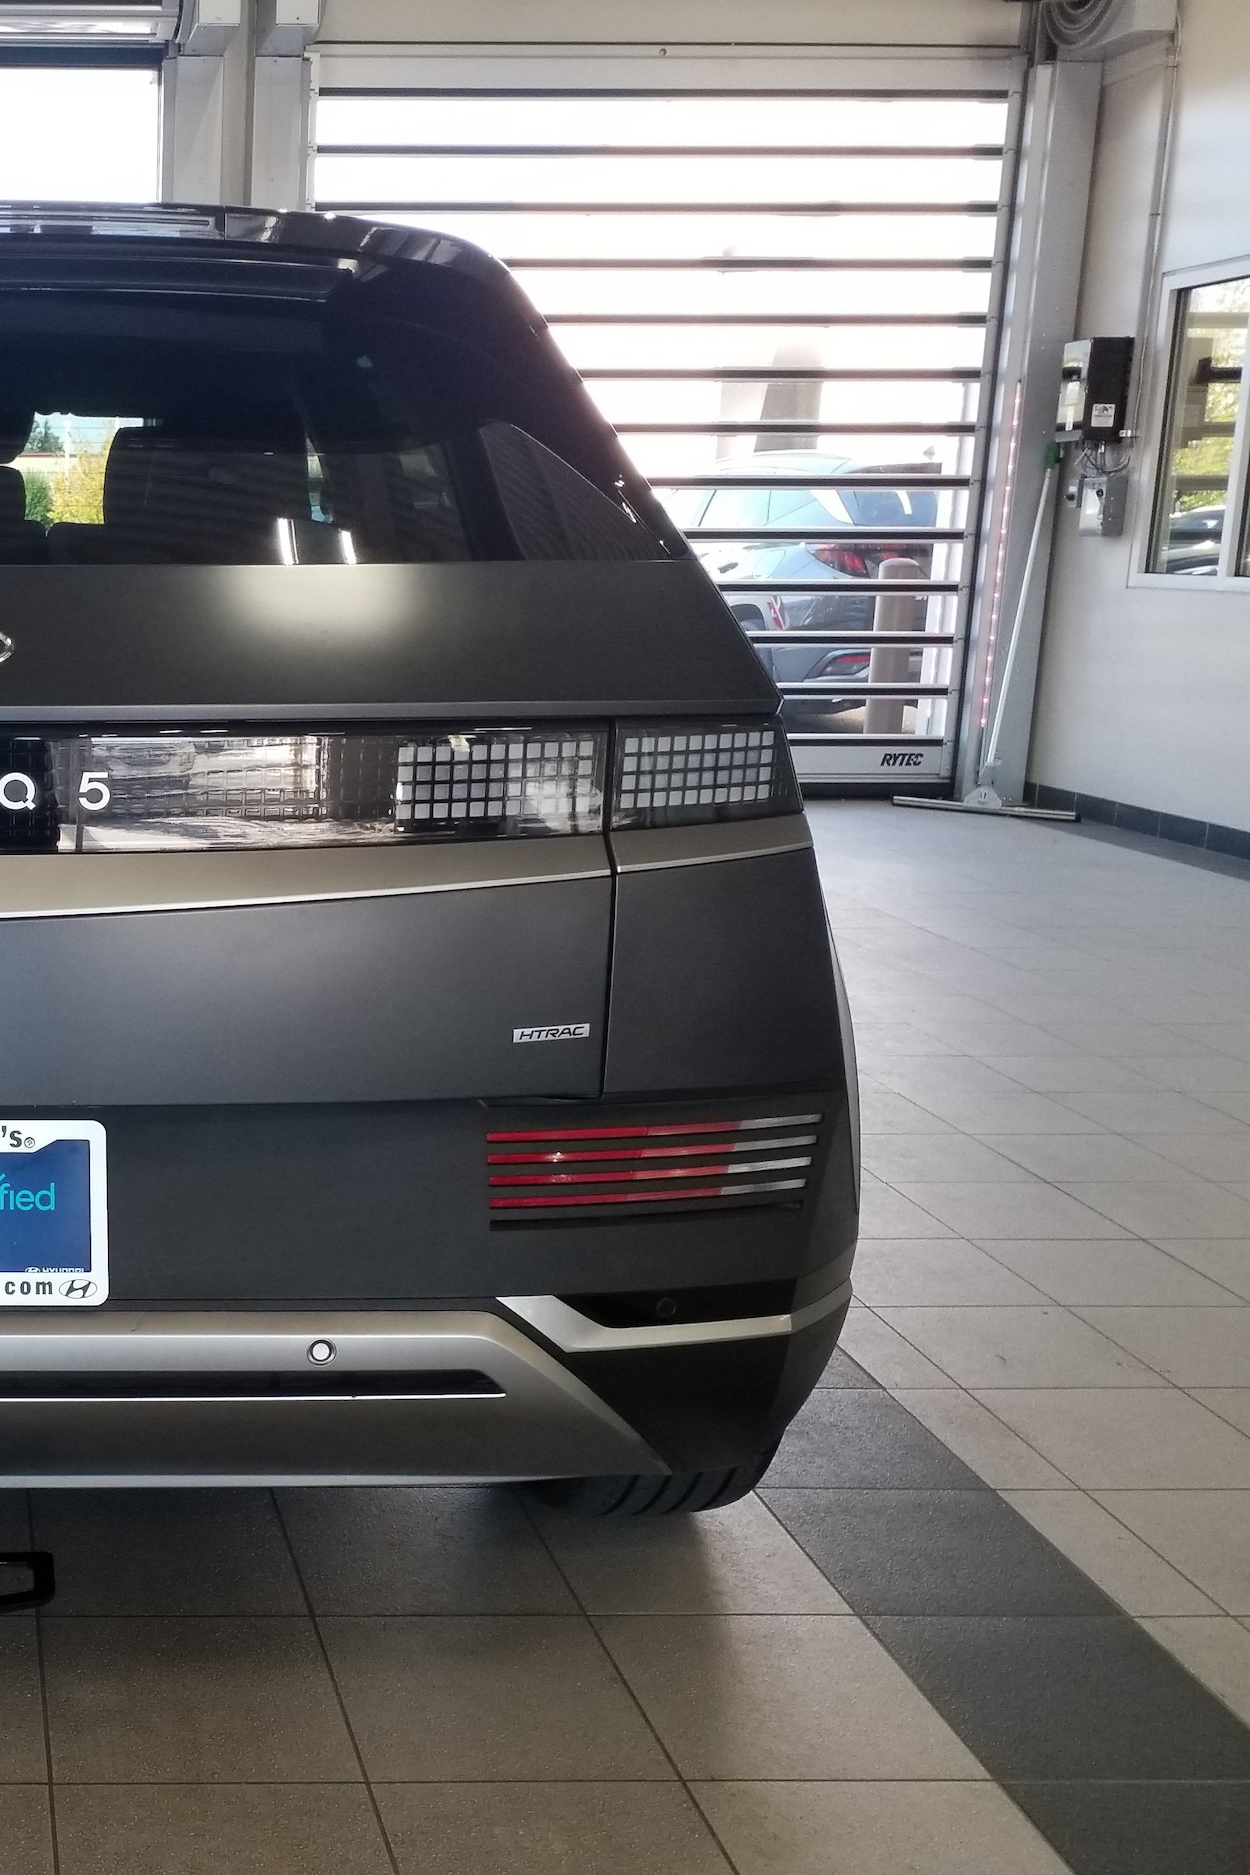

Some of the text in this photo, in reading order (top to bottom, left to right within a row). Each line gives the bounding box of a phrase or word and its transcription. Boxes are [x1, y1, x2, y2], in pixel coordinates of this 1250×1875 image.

[880, 753, 924, 767] RYTEC
[77, 771, 111, 811] 5
[519, 1026, 585, 1040] HTRAC
